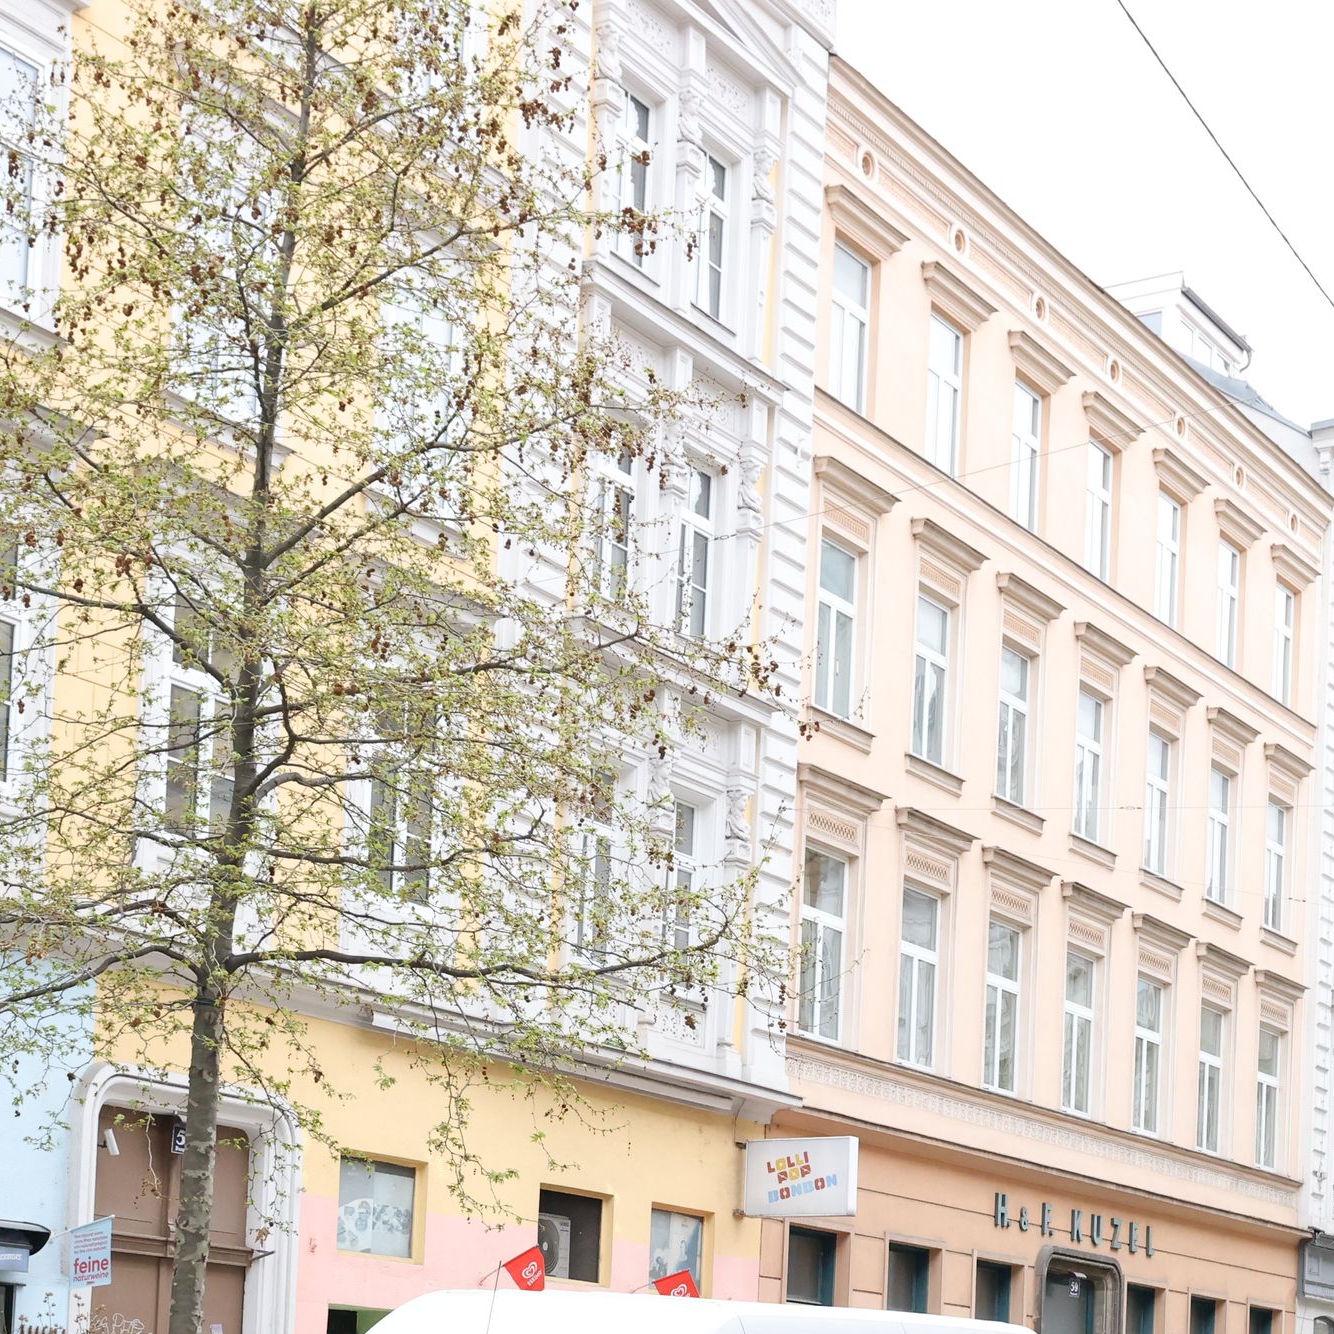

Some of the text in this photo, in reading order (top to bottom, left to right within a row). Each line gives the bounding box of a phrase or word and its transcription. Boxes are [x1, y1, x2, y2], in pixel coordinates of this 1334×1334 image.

[766, 1151, 809, 1174] LOLLI
[777, 1164, 812, 1184] POP
[768, 1174, 838, 1204] BONBON
[994, 1192, 1156, 1258] H. & F. KUZEL
[73, 1255, 109, 1275] feine
[1069, 1281, 1079, 1293] 59
